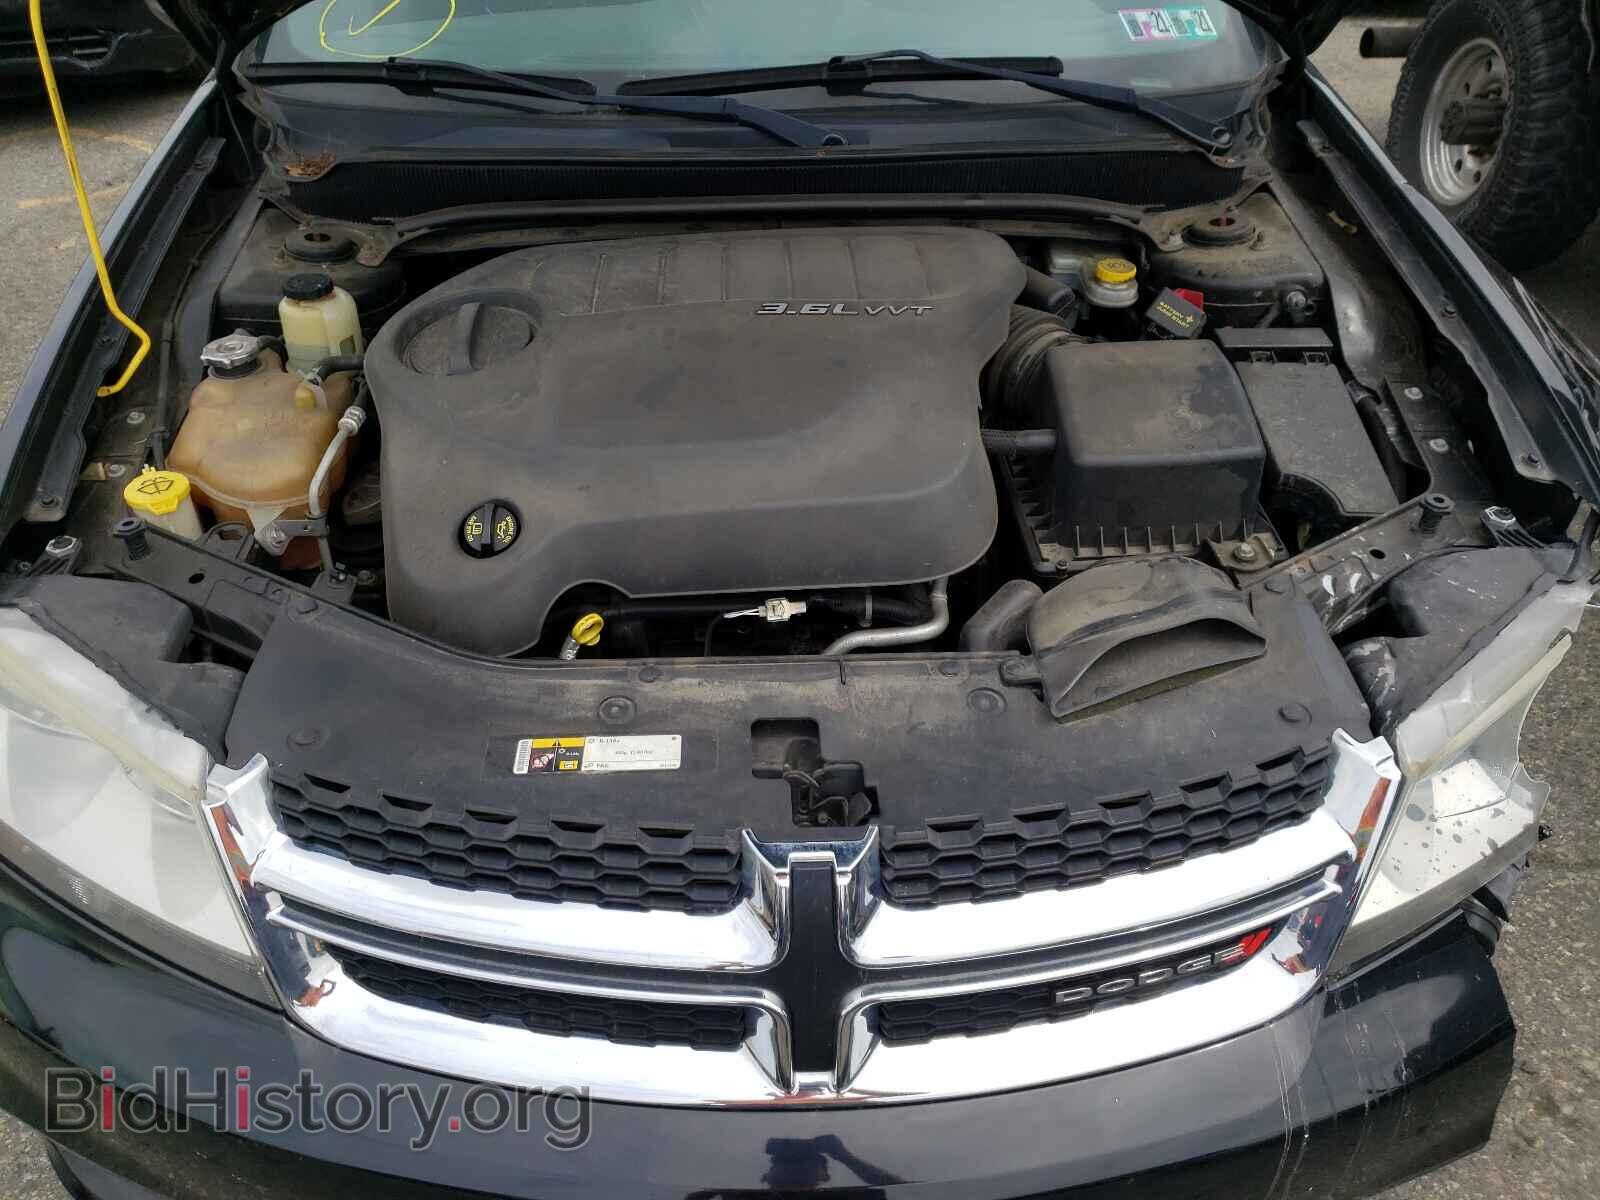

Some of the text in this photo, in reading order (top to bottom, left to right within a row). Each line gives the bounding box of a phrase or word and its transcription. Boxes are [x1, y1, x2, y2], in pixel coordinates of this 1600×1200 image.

[756, 303, 934, 315] 3.6L VVT
[1055, 942, 1247, 1004] DODGE
